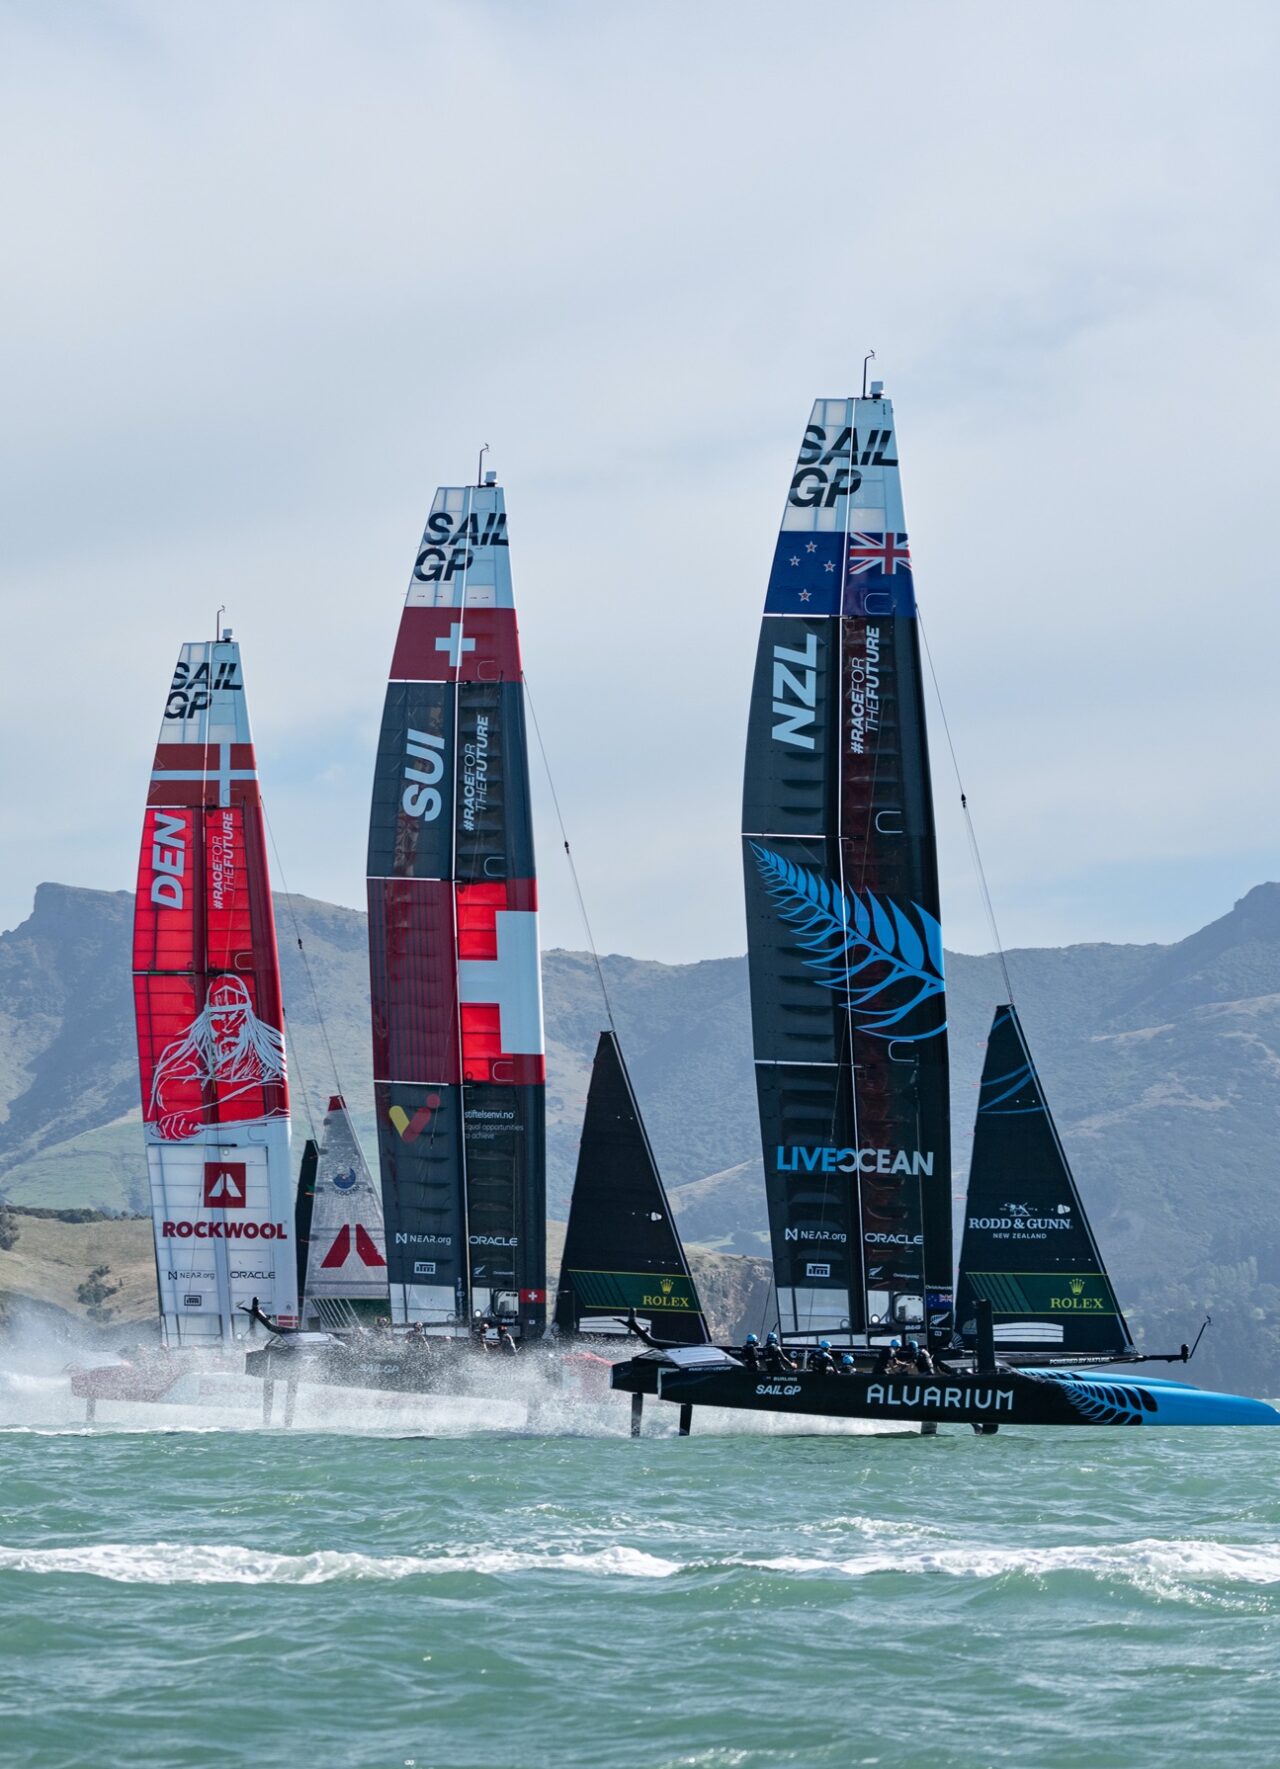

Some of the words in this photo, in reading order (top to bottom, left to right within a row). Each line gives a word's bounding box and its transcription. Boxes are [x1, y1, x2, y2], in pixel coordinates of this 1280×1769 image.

[798, 424, 899, 466] SAIL
[788, 467, 862, 508] GP
[424, 512, 509, 546] SAIL
[414, 548, 474, 581] GP
[170, 662, 243, 690] SAIL
[164, 691, 213, 719] GP
[772, 633, 817, 750] NZL
[402, 728, 446, 822] SUI
[151, 813, 187, 910] DEN
[162, 1221, 287, 1239] ROCKWOOL
[801, 1230, 846, 1243] NEAR.org
[865, 1232, 924, 1244] ORACLE
[969, 1218, 1011, 1229] RODD
[1013, 1218, 1025, 1229] &
[1026, 1218, 1071, 1230] GUNN
[410, 1235, 452, 1246] NEAR.org
[469, 1235, 518, 1246] ORACLE
[230, 1271, 276, 1279] ORACLE
[643, 1295, 689, 1307] ROLEX
[1050, 1298, 1104, 1309] ROLEX
[756, 1384, 782, 1395] SAIL
[783, 1385, 802, 1395] GP
